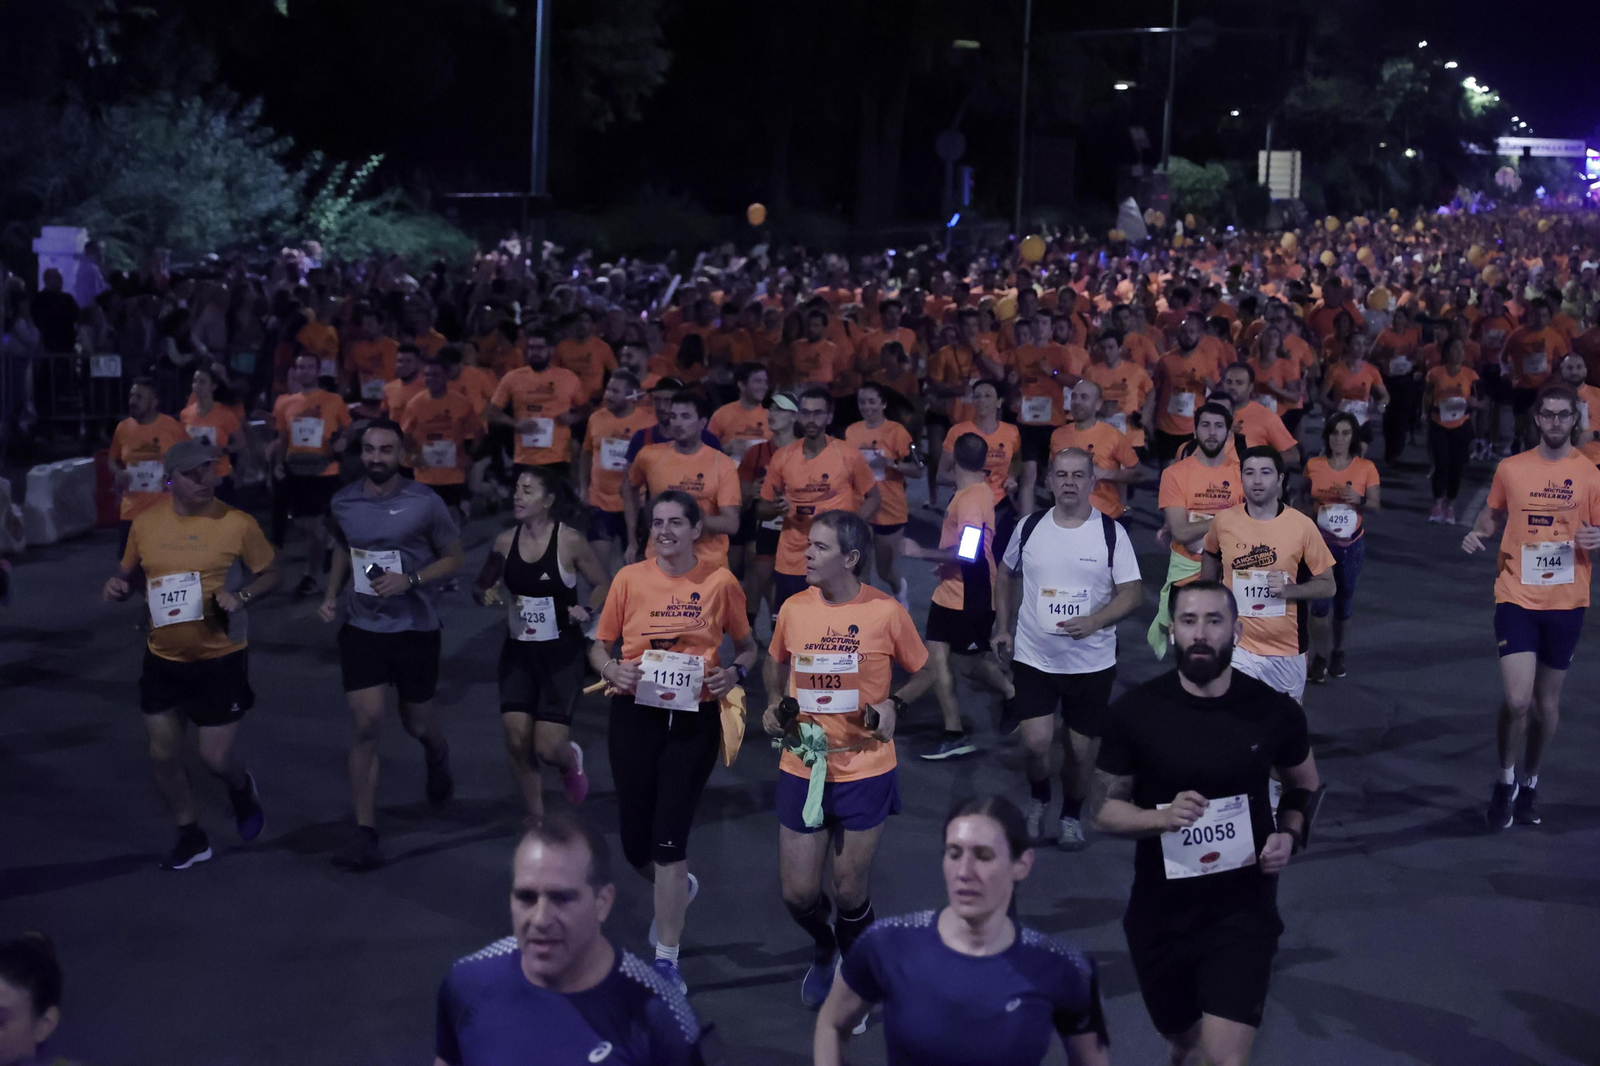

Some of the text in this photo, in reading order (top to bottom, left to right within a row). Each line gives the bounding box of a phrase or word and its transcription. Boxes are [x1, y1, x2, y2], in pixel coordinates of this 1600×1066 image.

[1328, 515, 1349, 524] 4295
[1536, 556, 1562, 567] 7144
[160, 590, 187, 605] 7477
[666, 604, 702, 612] NOCTURNA
[1048, 603, 1080, 616] 14101
[650, 610, 682, 618] SEVILLA
[820, 636, 860, 646] NOCTURNA
[804, 643, 859, 654] SEVILLA KH7
[653, 669, 691, 687] 11131
[810, 674, 842, 689] 1123
[1181, 822, 1236, 846] 20058
